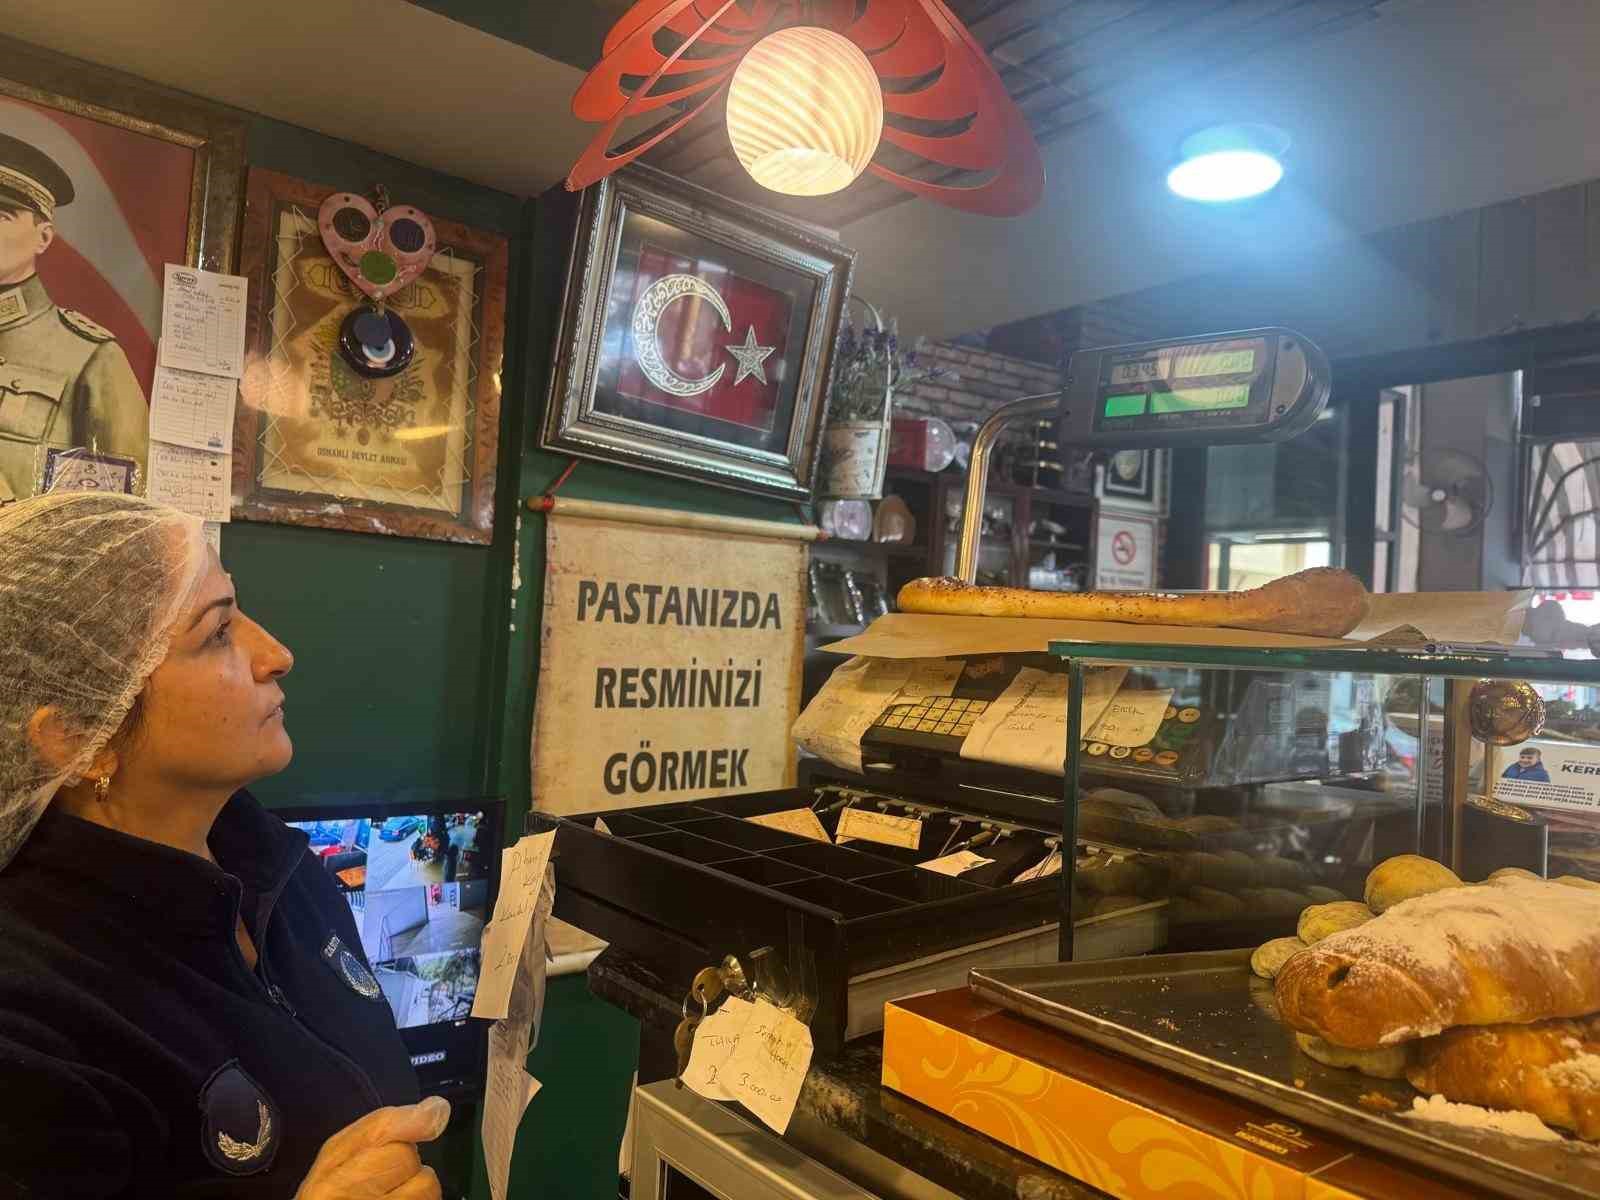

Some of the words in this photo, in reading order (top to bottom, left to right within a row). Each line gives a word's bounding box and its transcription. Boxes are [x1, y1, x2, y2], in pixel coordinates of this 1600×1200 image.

[577, 580, 782, 630] PASTANIZDA
[594, 657, 762, 709] RESMİNİZİ
[603, 740, 749, 796] GÖRMEK
